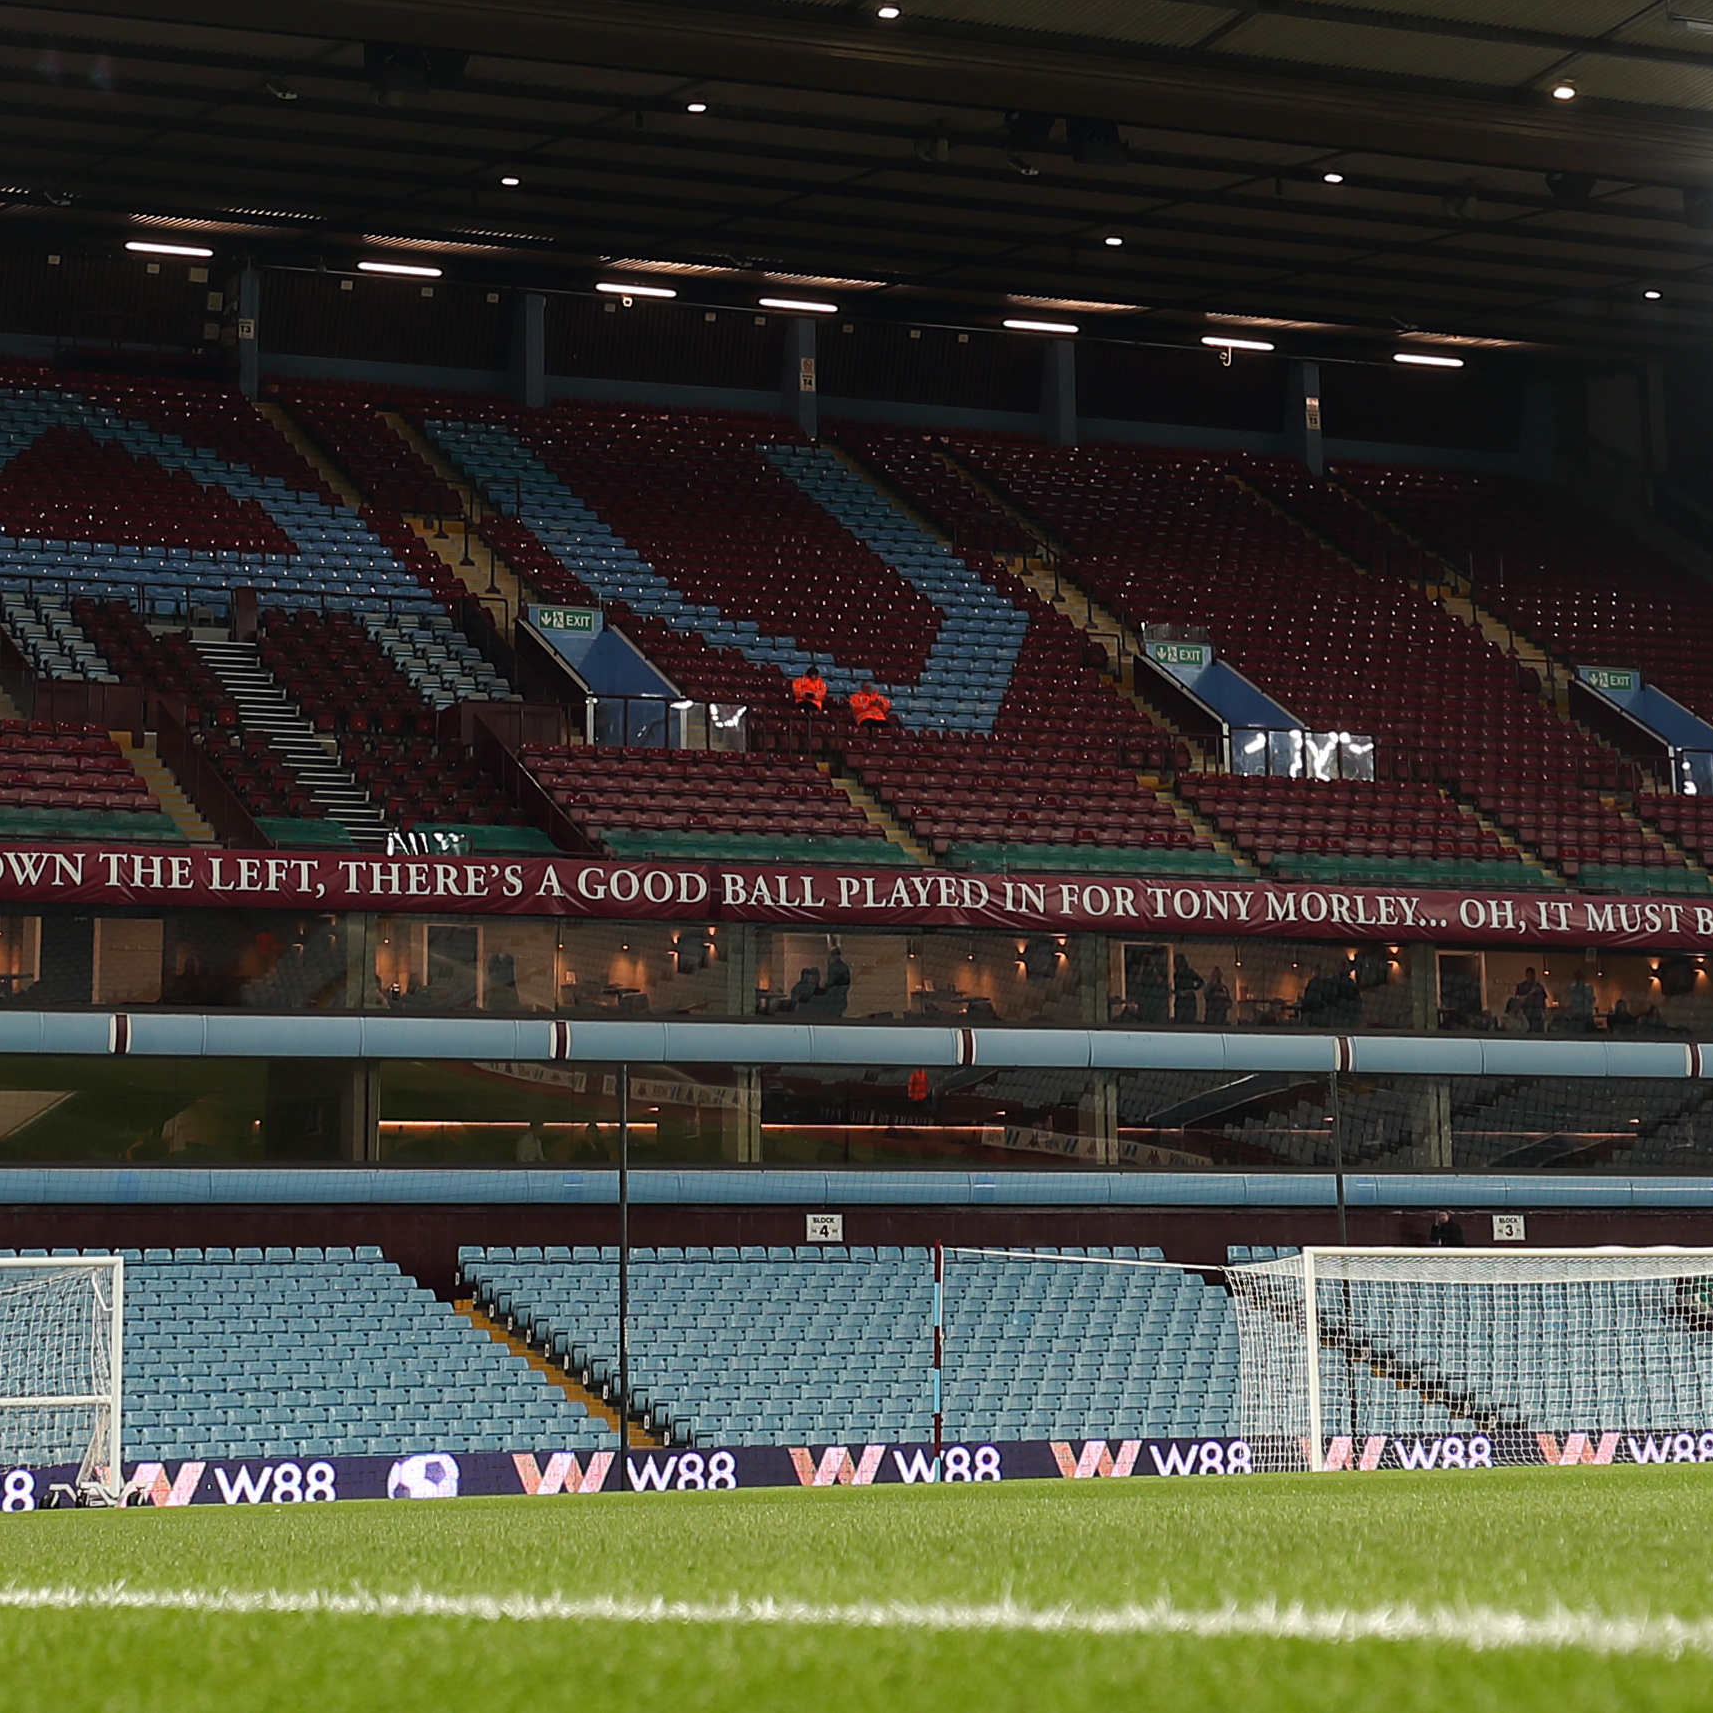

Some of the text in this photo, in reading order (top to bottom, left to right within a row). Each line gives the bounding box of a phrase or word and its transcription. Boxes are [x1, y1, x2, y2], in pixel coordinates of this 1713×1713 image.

[566, 616, 590, 628] EXIT
[1179, 648, 1201, 661] EXIT
[1610, 675, 1631, 686] EXIT
[99, 853, 193, 888] THE
[209, 858, 324, 898] LEFT,
[536, 865, 564, 896] A
[578, 868, 706, 902] GOOD
[722, 874, 825, 906] BALL
[837, 877, 989, 908] PLAYED
[1002, 882, 1045, 913] IN
[1059, 884, 1138, 916] FOR
[1147, 888, 1254, 920] TONY
[1460, 899, 1525, 933] OH,
[1536, 902, 1573, 930] IT
[1584, 904, 1683, 932] MUST
[819, 1224, 830, 1238] 4
[1498, 1217, 1518, 1225] BLOCK
[1504, 1224, 1514, 1237] 3
[893, 1445, 1001, 1483] W88
[1149, 1439, 1252, 1475] W88
[1393, 1435, 1493, 1469] W88
[215, 1461, 336, 1504] W88
[625, 1451, 736, 1490] W88
